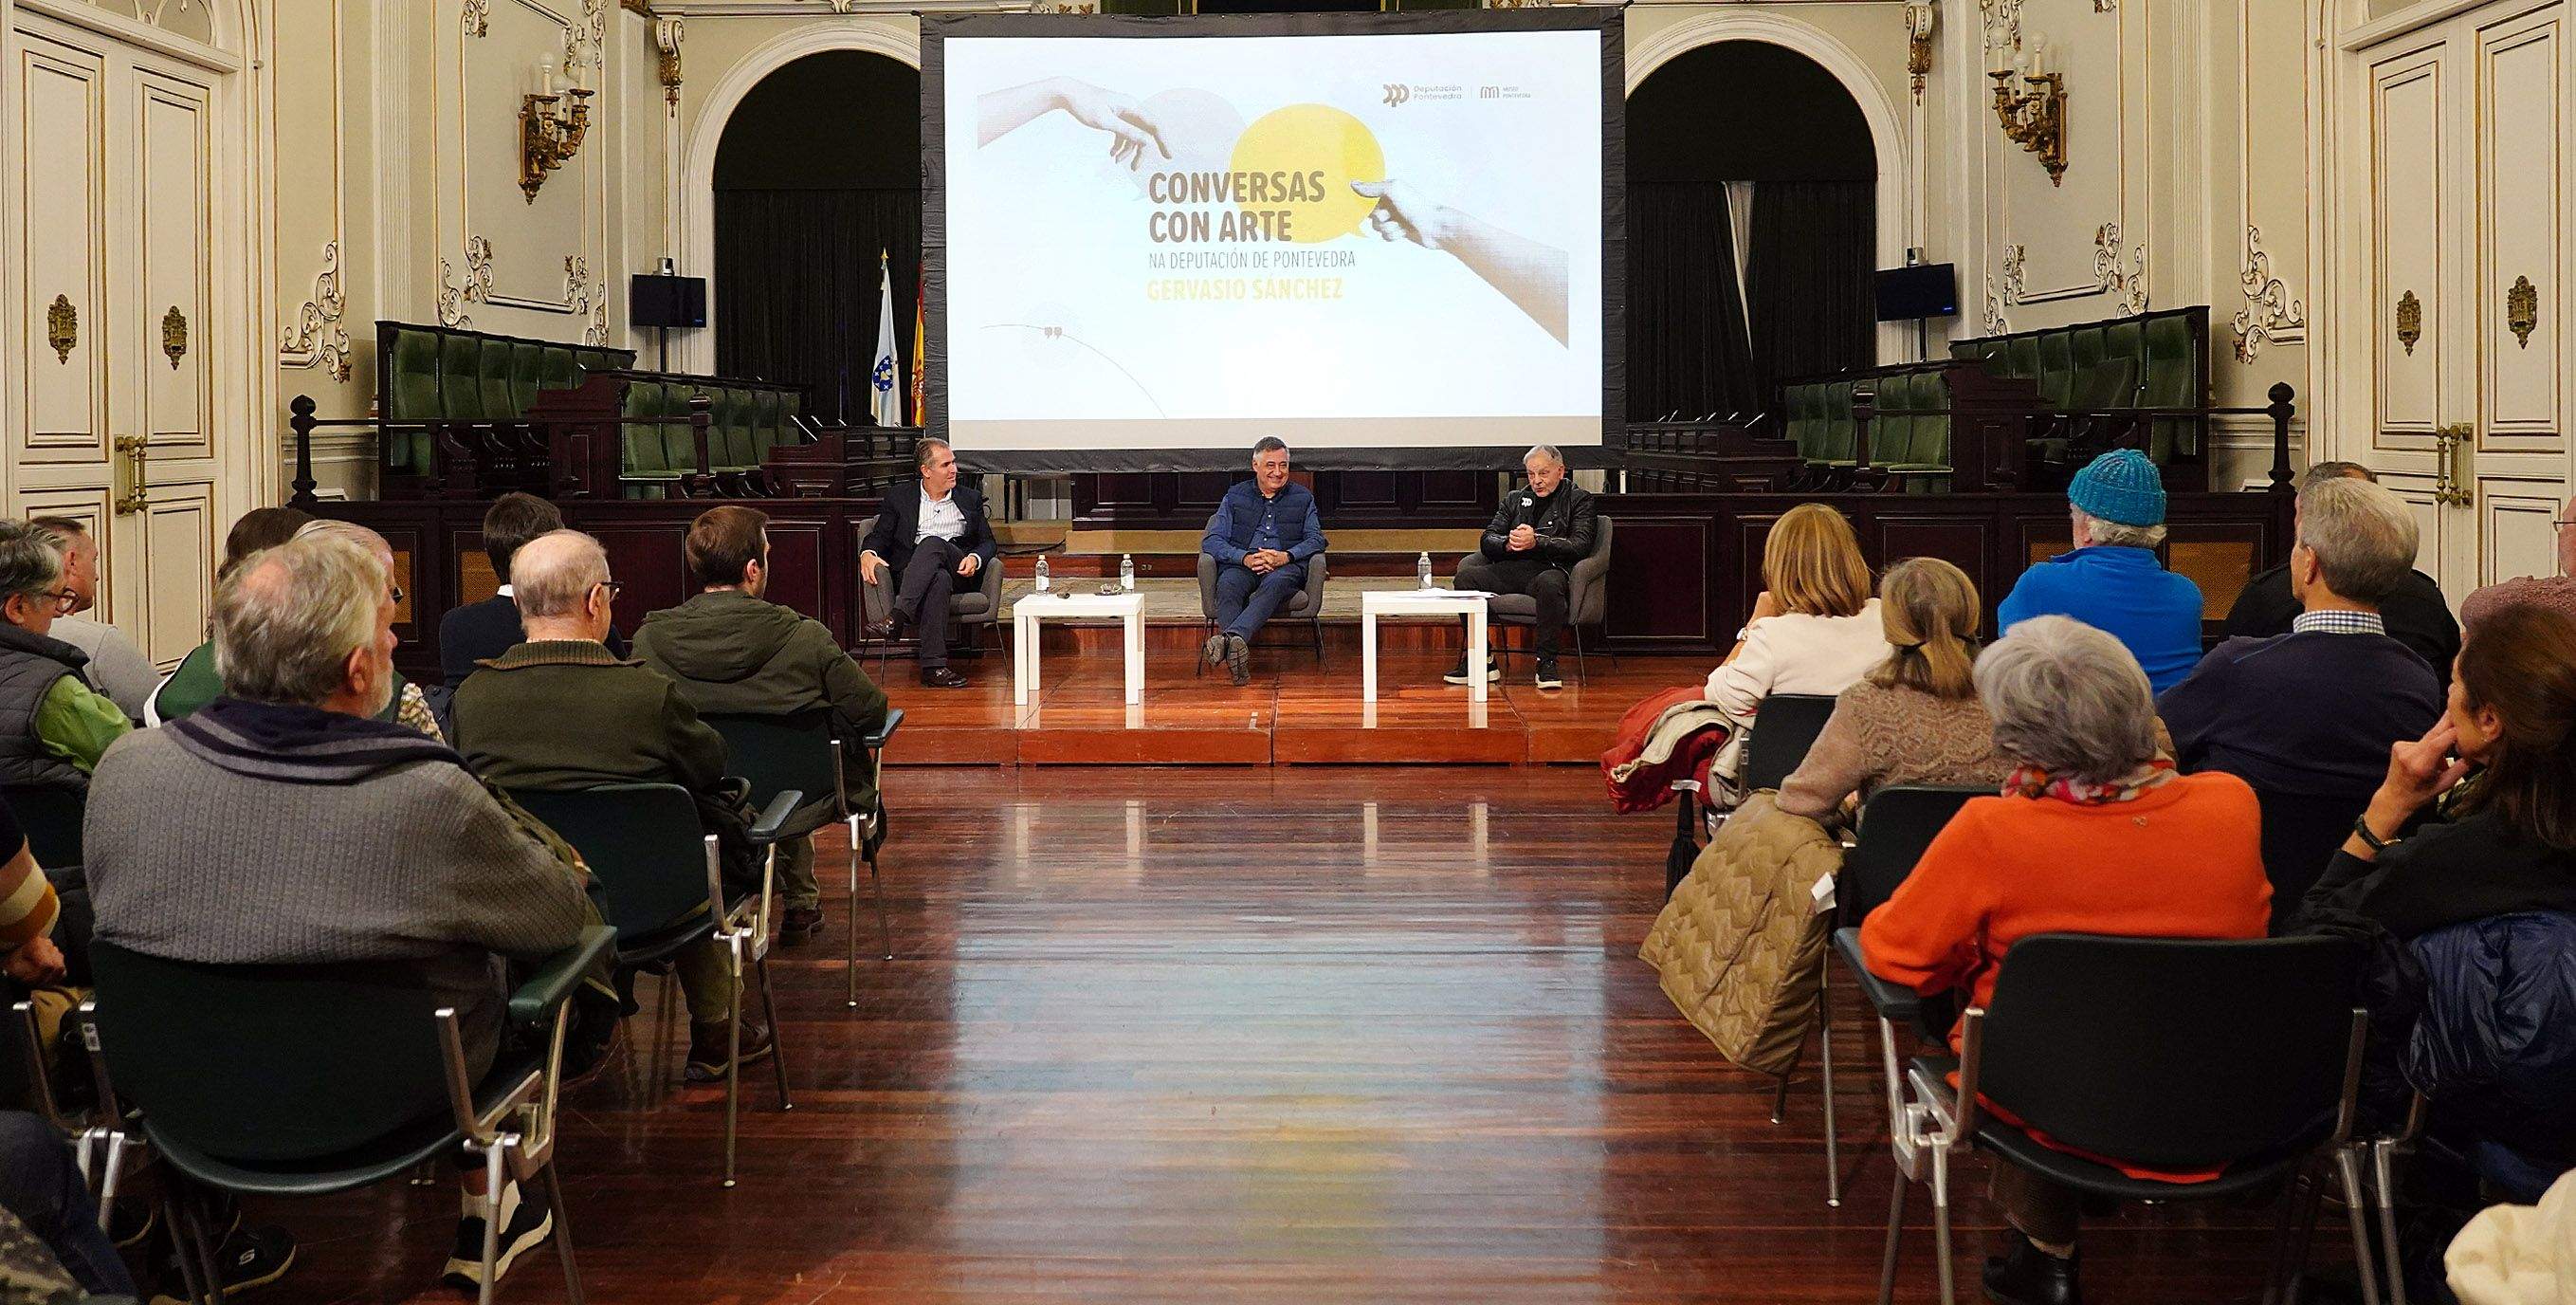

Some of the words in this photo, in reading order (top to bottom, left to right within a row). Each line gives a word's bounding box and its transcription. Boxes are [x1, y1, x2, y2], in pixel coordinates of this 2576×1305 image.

[1414, 84, 1462, 94] Deputación
[1414, 92, 1462, 101] Pontevedra
[1148, 171, 1325, 204] CONVERSAS
[1148, 211, 1210, 243] CON
[1218, 210, 1292, 243] ARTE
[1149, 251, 1165, 269] NA
[1170, 248, 1248, 269] DEPUTACIÓN
[1253, 251, 1269, 268] DE
[1273, 250, 1356, 268] PONTEVEDRA
[1147, 278, 1246, 302] GERVASIO
[1251, 272, 1343, 301] SÁNCHEZ
